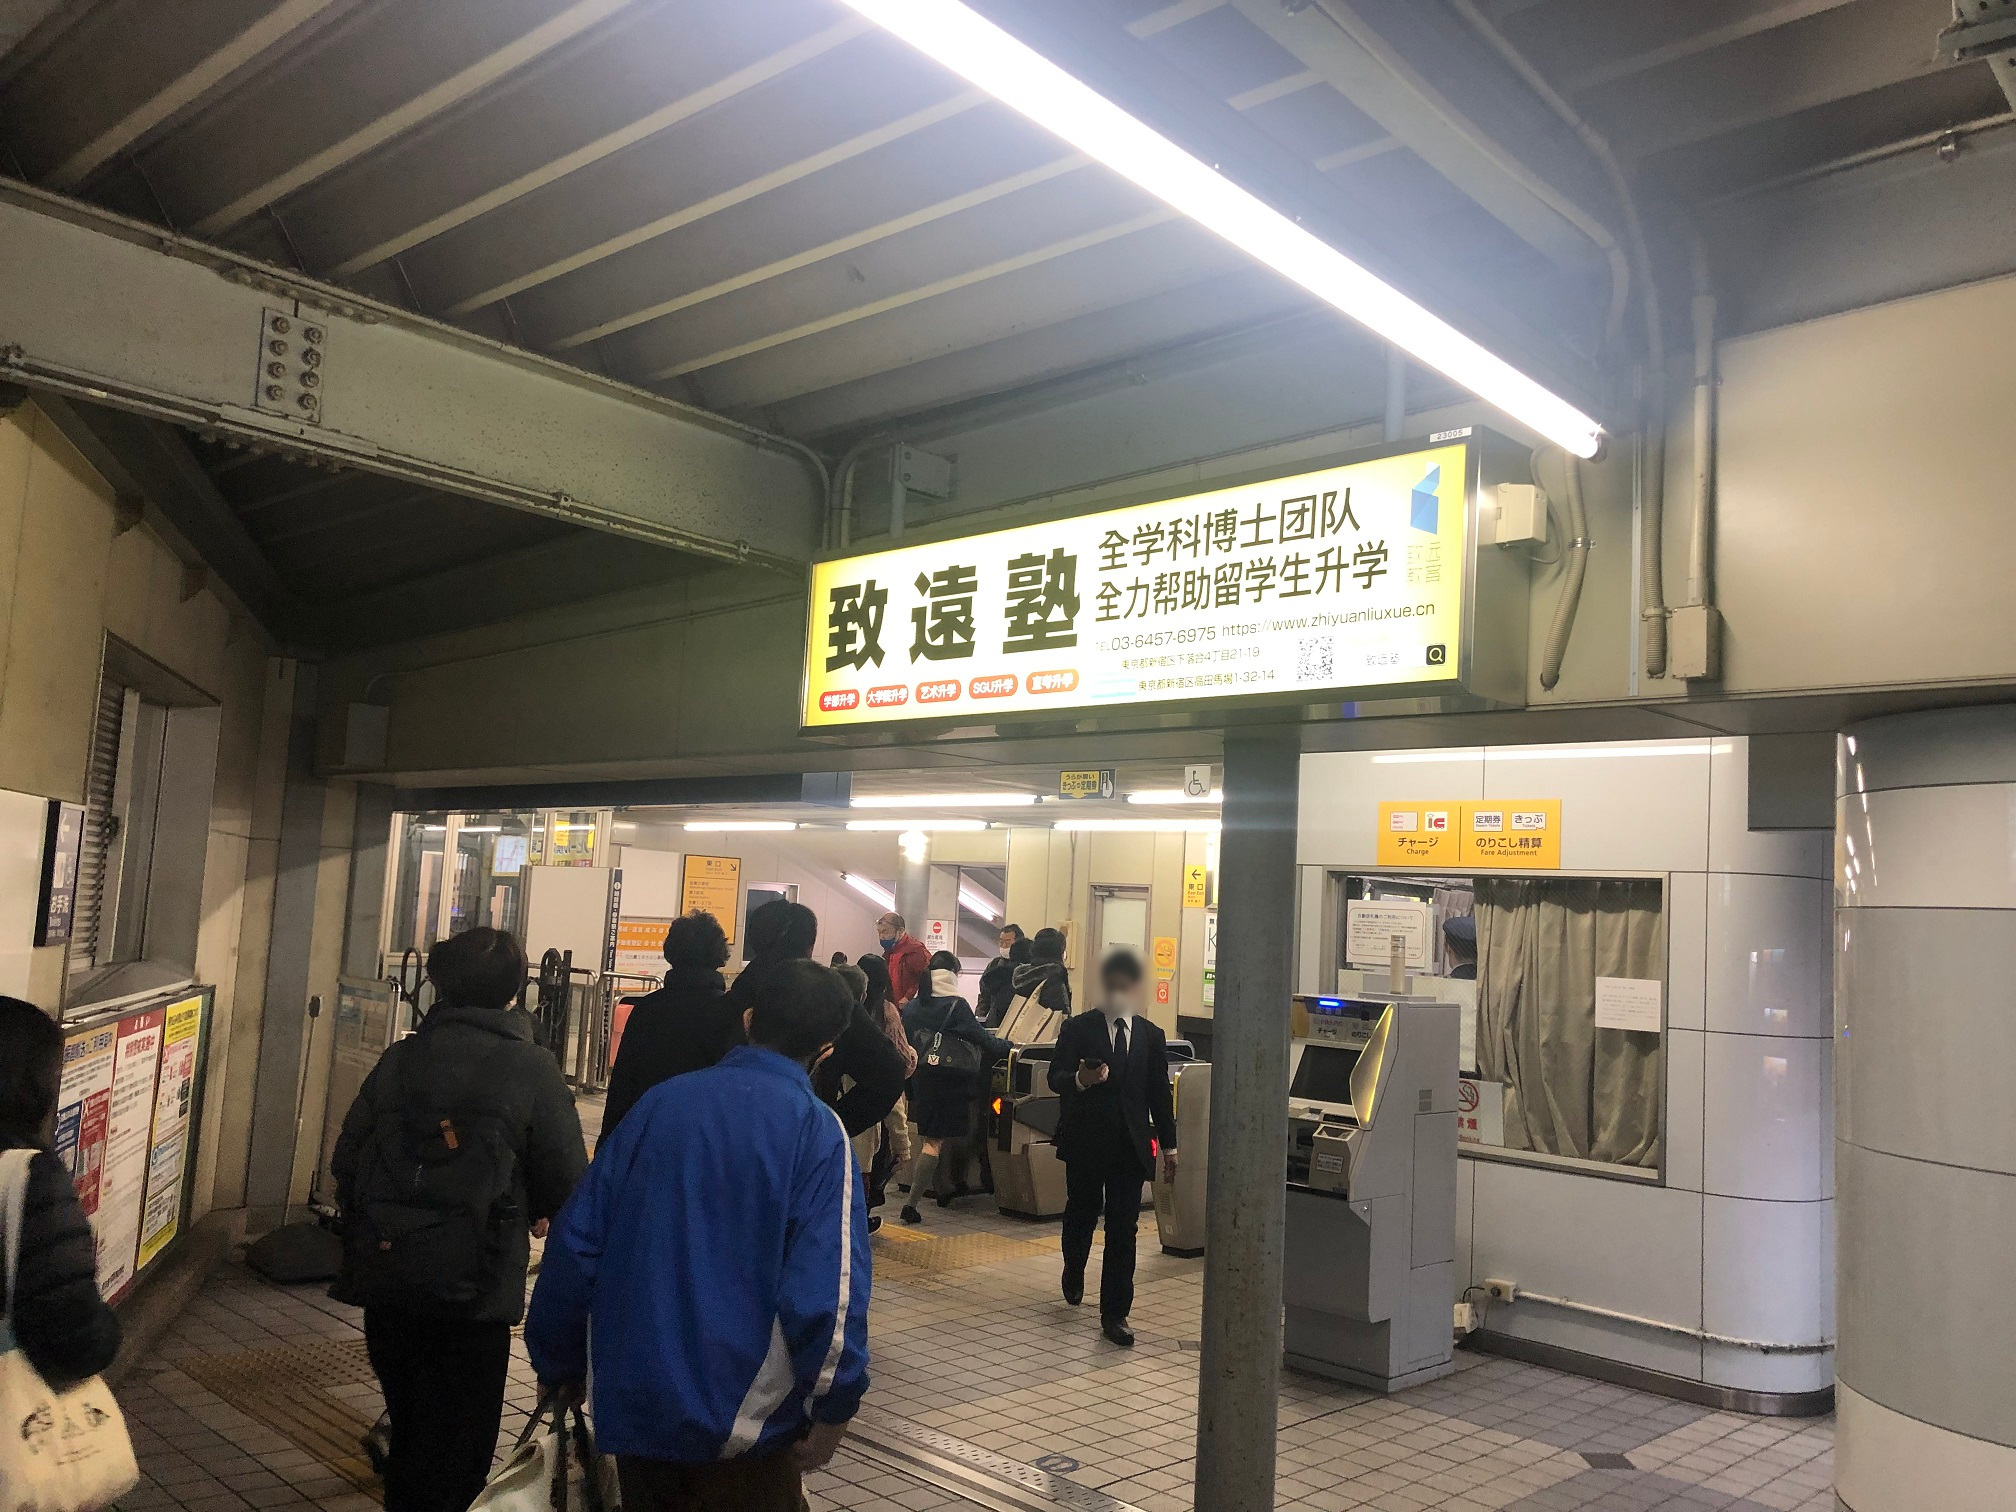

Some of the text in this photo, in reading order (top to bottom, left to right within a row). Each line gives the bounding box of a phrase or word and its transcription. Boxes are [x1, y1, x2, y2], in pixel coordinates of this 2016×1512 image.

[1436, 428, 1463, 440] 23005
[1097, 486, 1361, 574] 全学科博士团队
[1095, 537, 1389, 625] 全力帮助留学生升学
[825, 547, 1081, 674] 致遠塾
[1111, 626, 1216, 651] 03-6457-6975
[1222, 602, 1436, 638] https://www.zhiyuanliuxue.cn
[972, 676, 1014, 695] SGU升学
[1138, 669, 1276, 691] 東京都新宿区高田馬場1-32-14
[920, 681, 957, 700] 艺术升学
[1475, 815, 1501, 824] 定期券
[1514, 814, 1544, 824] きっぷ
[1397, 836, 1439, 848] チャージ
[1475, 836, 1543, 849] のりこし精算
[1406, 847, 1430, 856] Charge
[1480, 848, 1538, 857] Fare Adjustment
